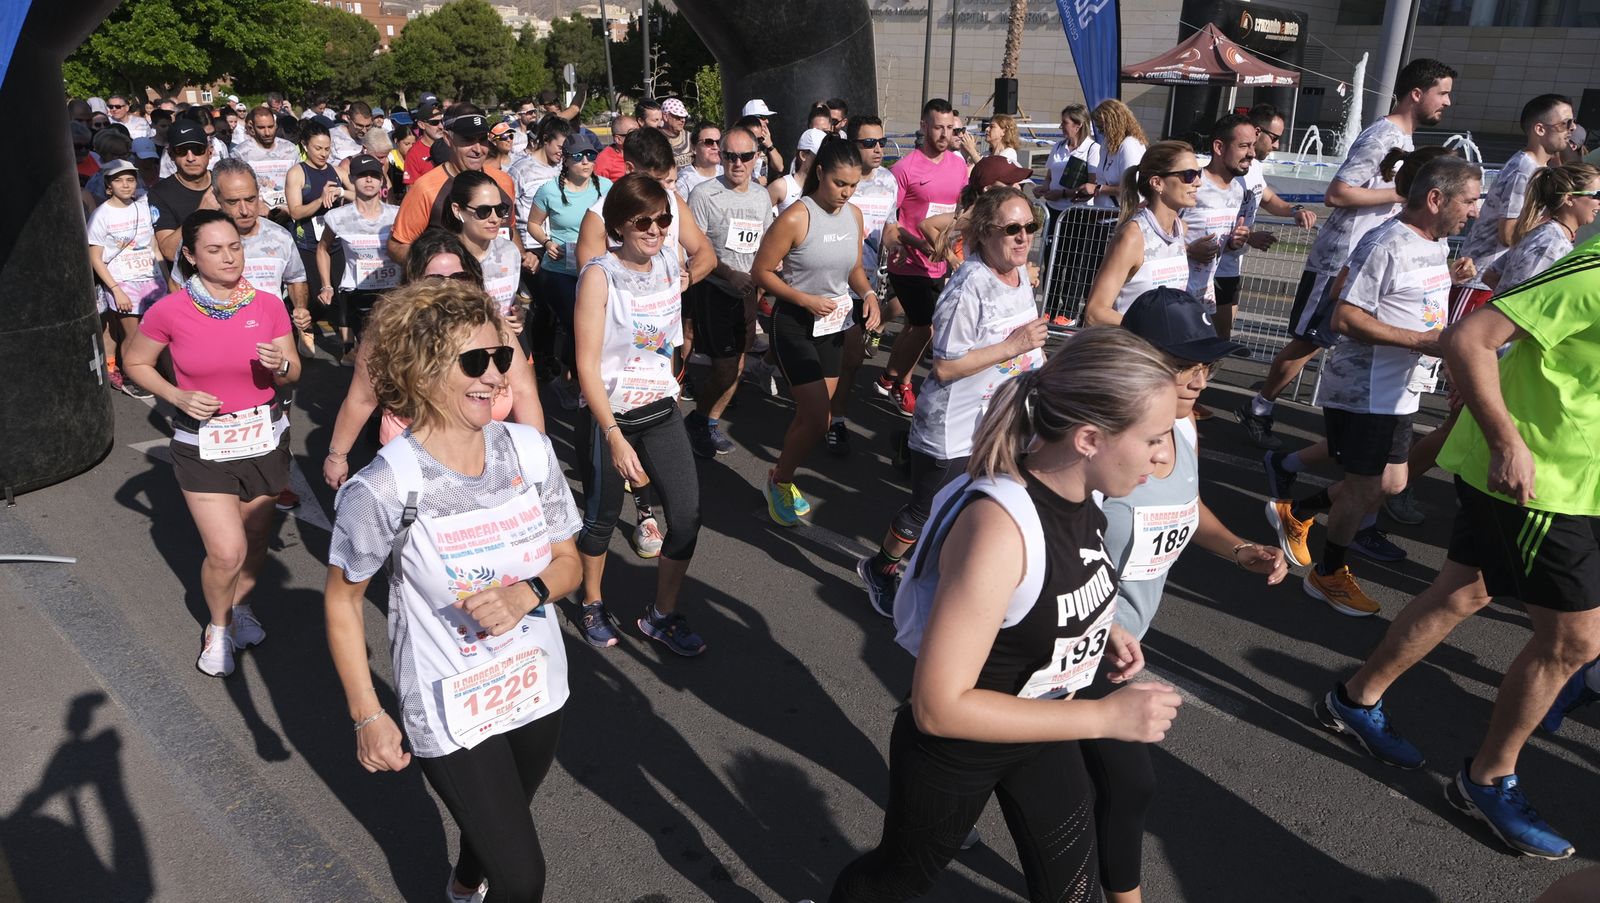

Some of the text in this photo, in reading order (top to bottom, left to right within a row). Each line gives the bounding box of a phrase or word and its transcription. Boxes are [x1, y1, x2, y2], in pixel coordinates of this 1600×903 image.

[738, 231, 759, 243] 101
[823, 233, 837, 243] NIKE
[126, 258, 155, 270] 1300
[363, 267, 397, 280] 1159
[209, 422, 264, 445] 1277
[444, 522, 500, 544] CARRERA
[499, 516, 519, 532] SIN
[1152, 525, 1190, 556] 189
[523, 551, 531, 562] 4
[1057, 564, 1114, 627] PUMA
[1061, 628, 1107, 673] 193
[462, 664, 500, 687] CARRERA
[515, 648, 540, 661] HUMO
[463, 664, 538, 717] 1226
